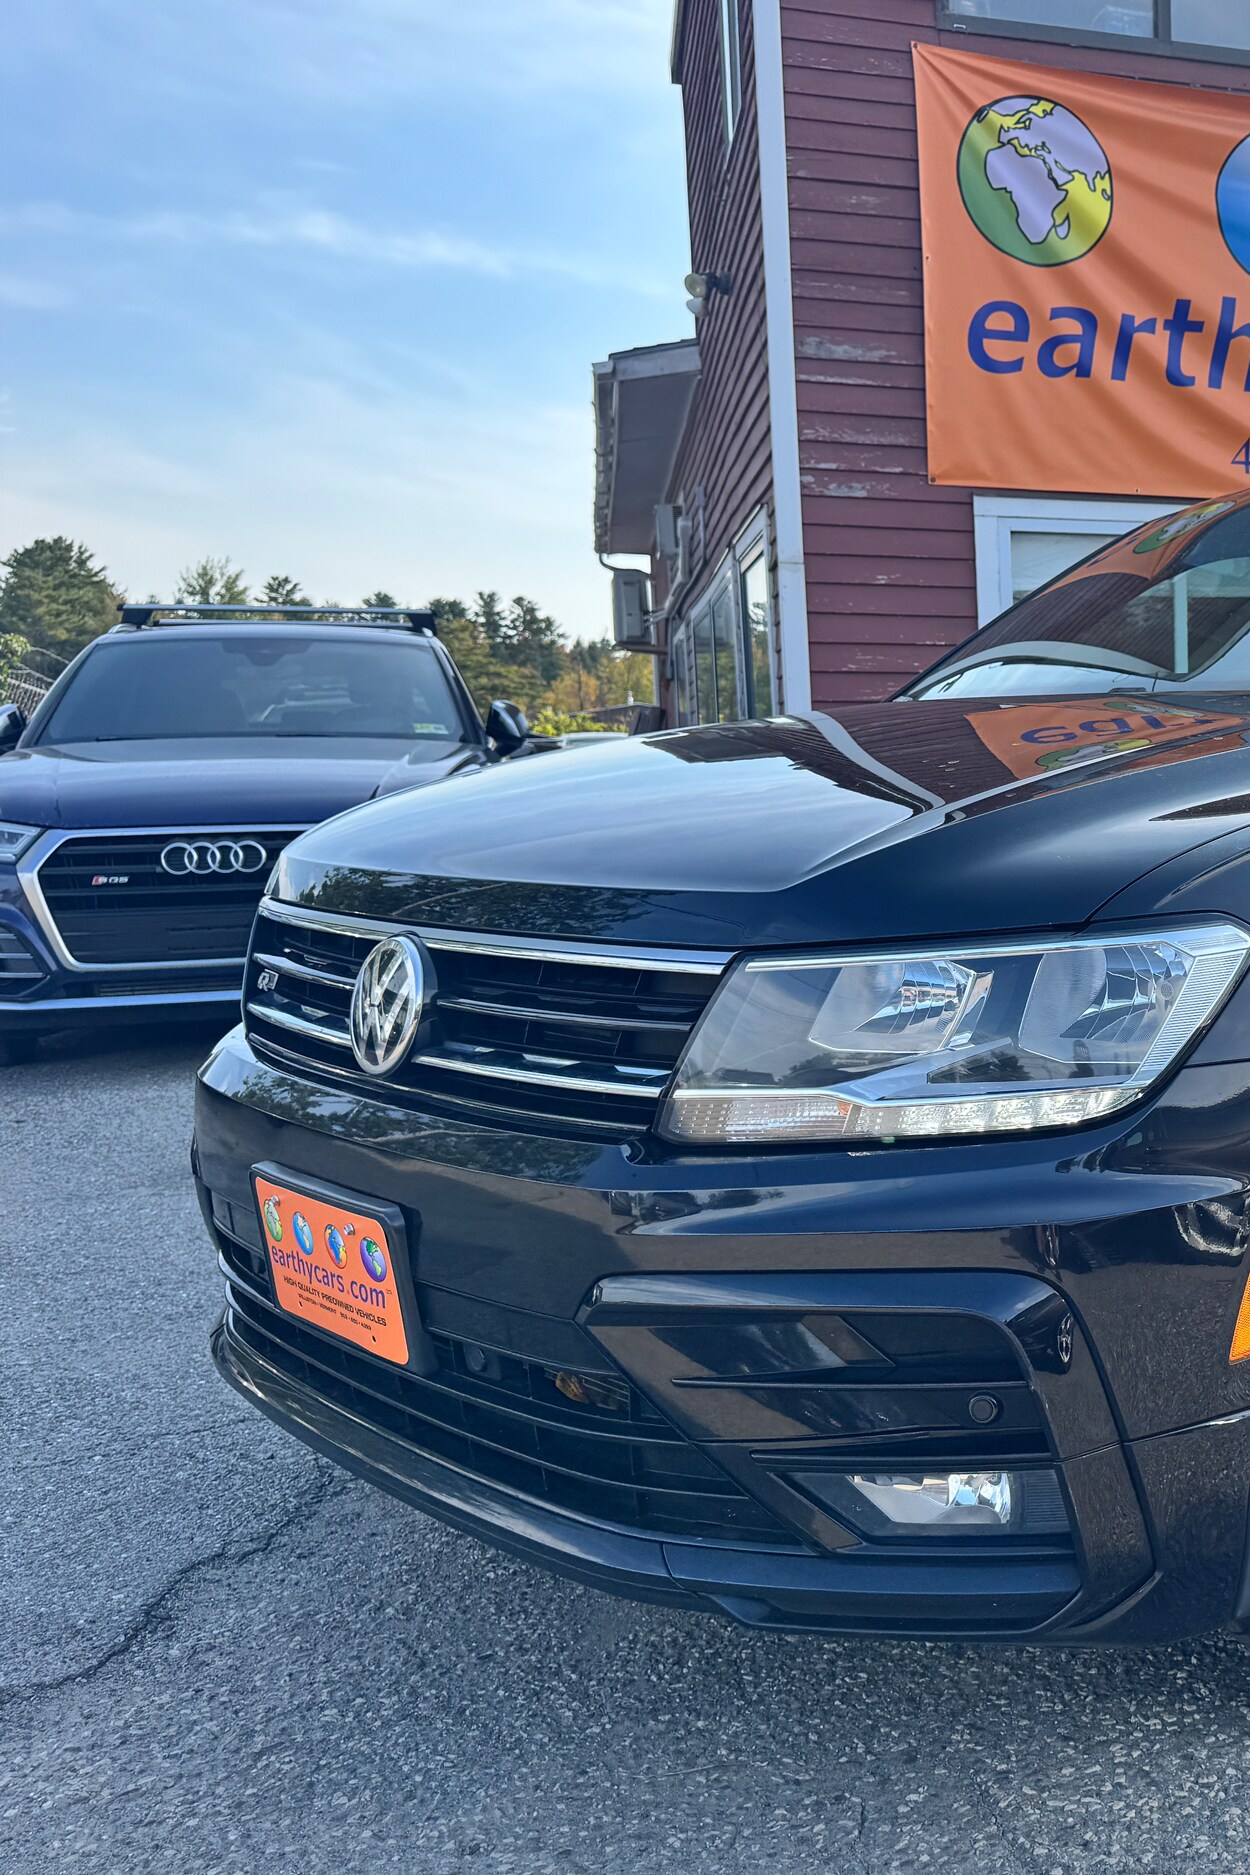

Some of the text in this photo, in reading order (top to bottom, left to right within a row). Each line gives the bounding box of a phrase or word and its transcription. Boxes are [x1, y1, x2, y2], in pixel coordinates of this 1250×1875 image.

[271, 1245, 386, 1309] earthycars.com
[297, 1282, 321, 1297] QUALITY
[355, 1307, 387, 1327] VEHICLES
